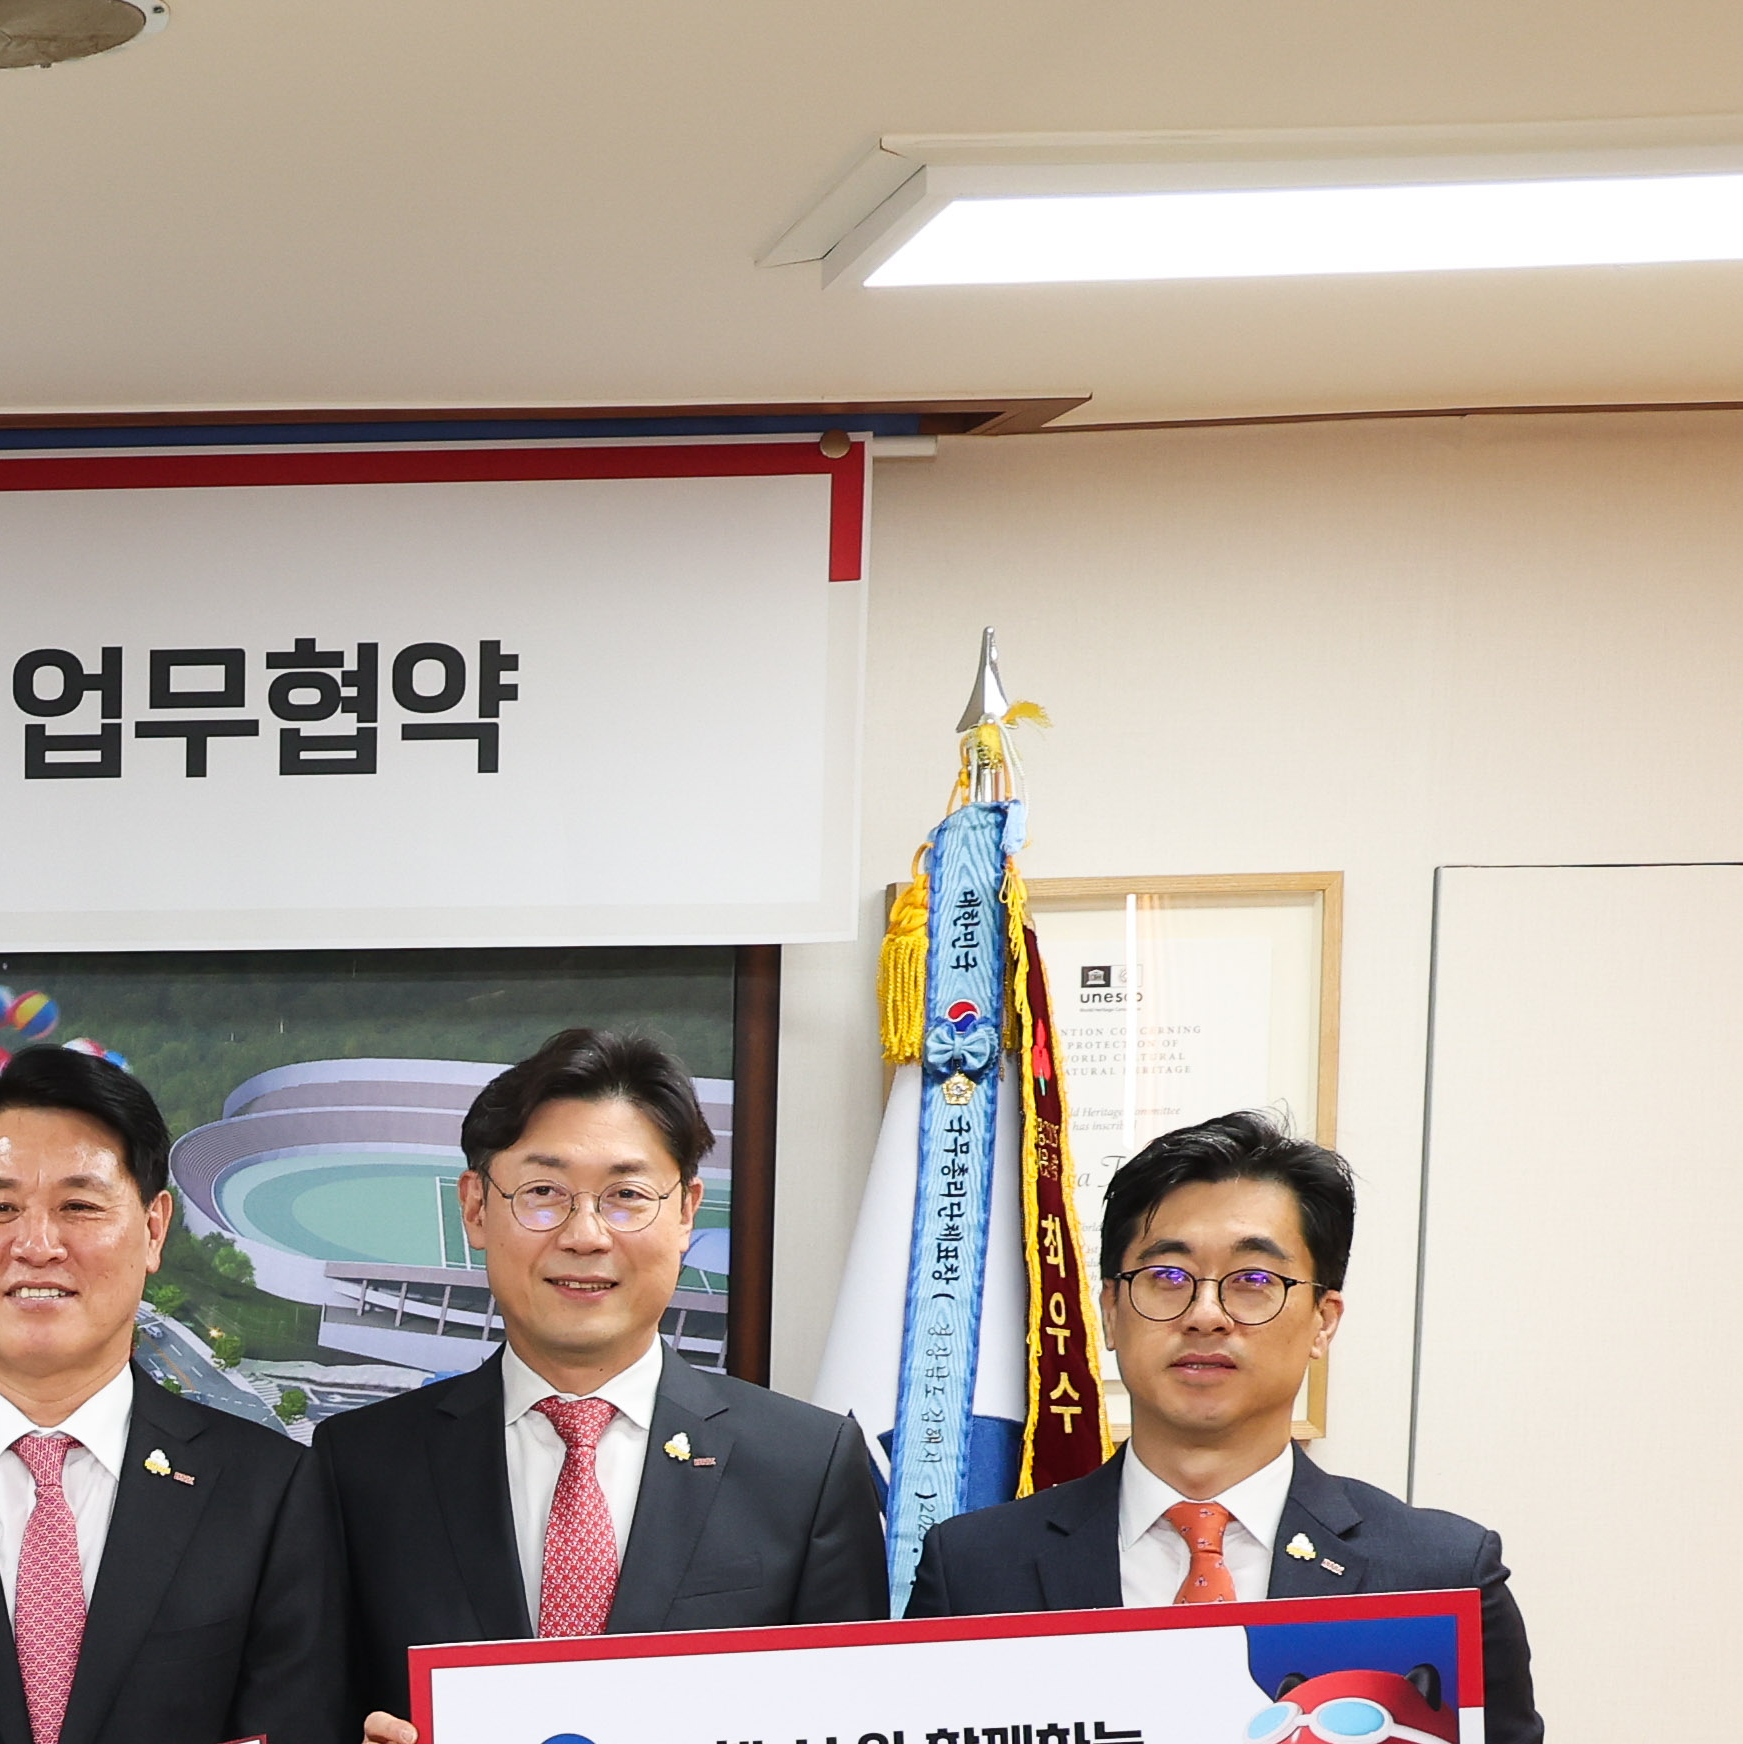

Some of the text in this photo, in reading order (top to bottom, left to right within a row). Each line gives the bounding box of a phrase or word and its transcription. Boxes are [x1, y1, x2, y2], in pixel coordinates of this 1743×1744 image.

[12, 637, 520, 780] 업무협약
[950, 889, 981, 973] 대한민국
[1060, 1027, 1104, 1036] NTION
[1041, 1214, 1083, 1434] 최우수
